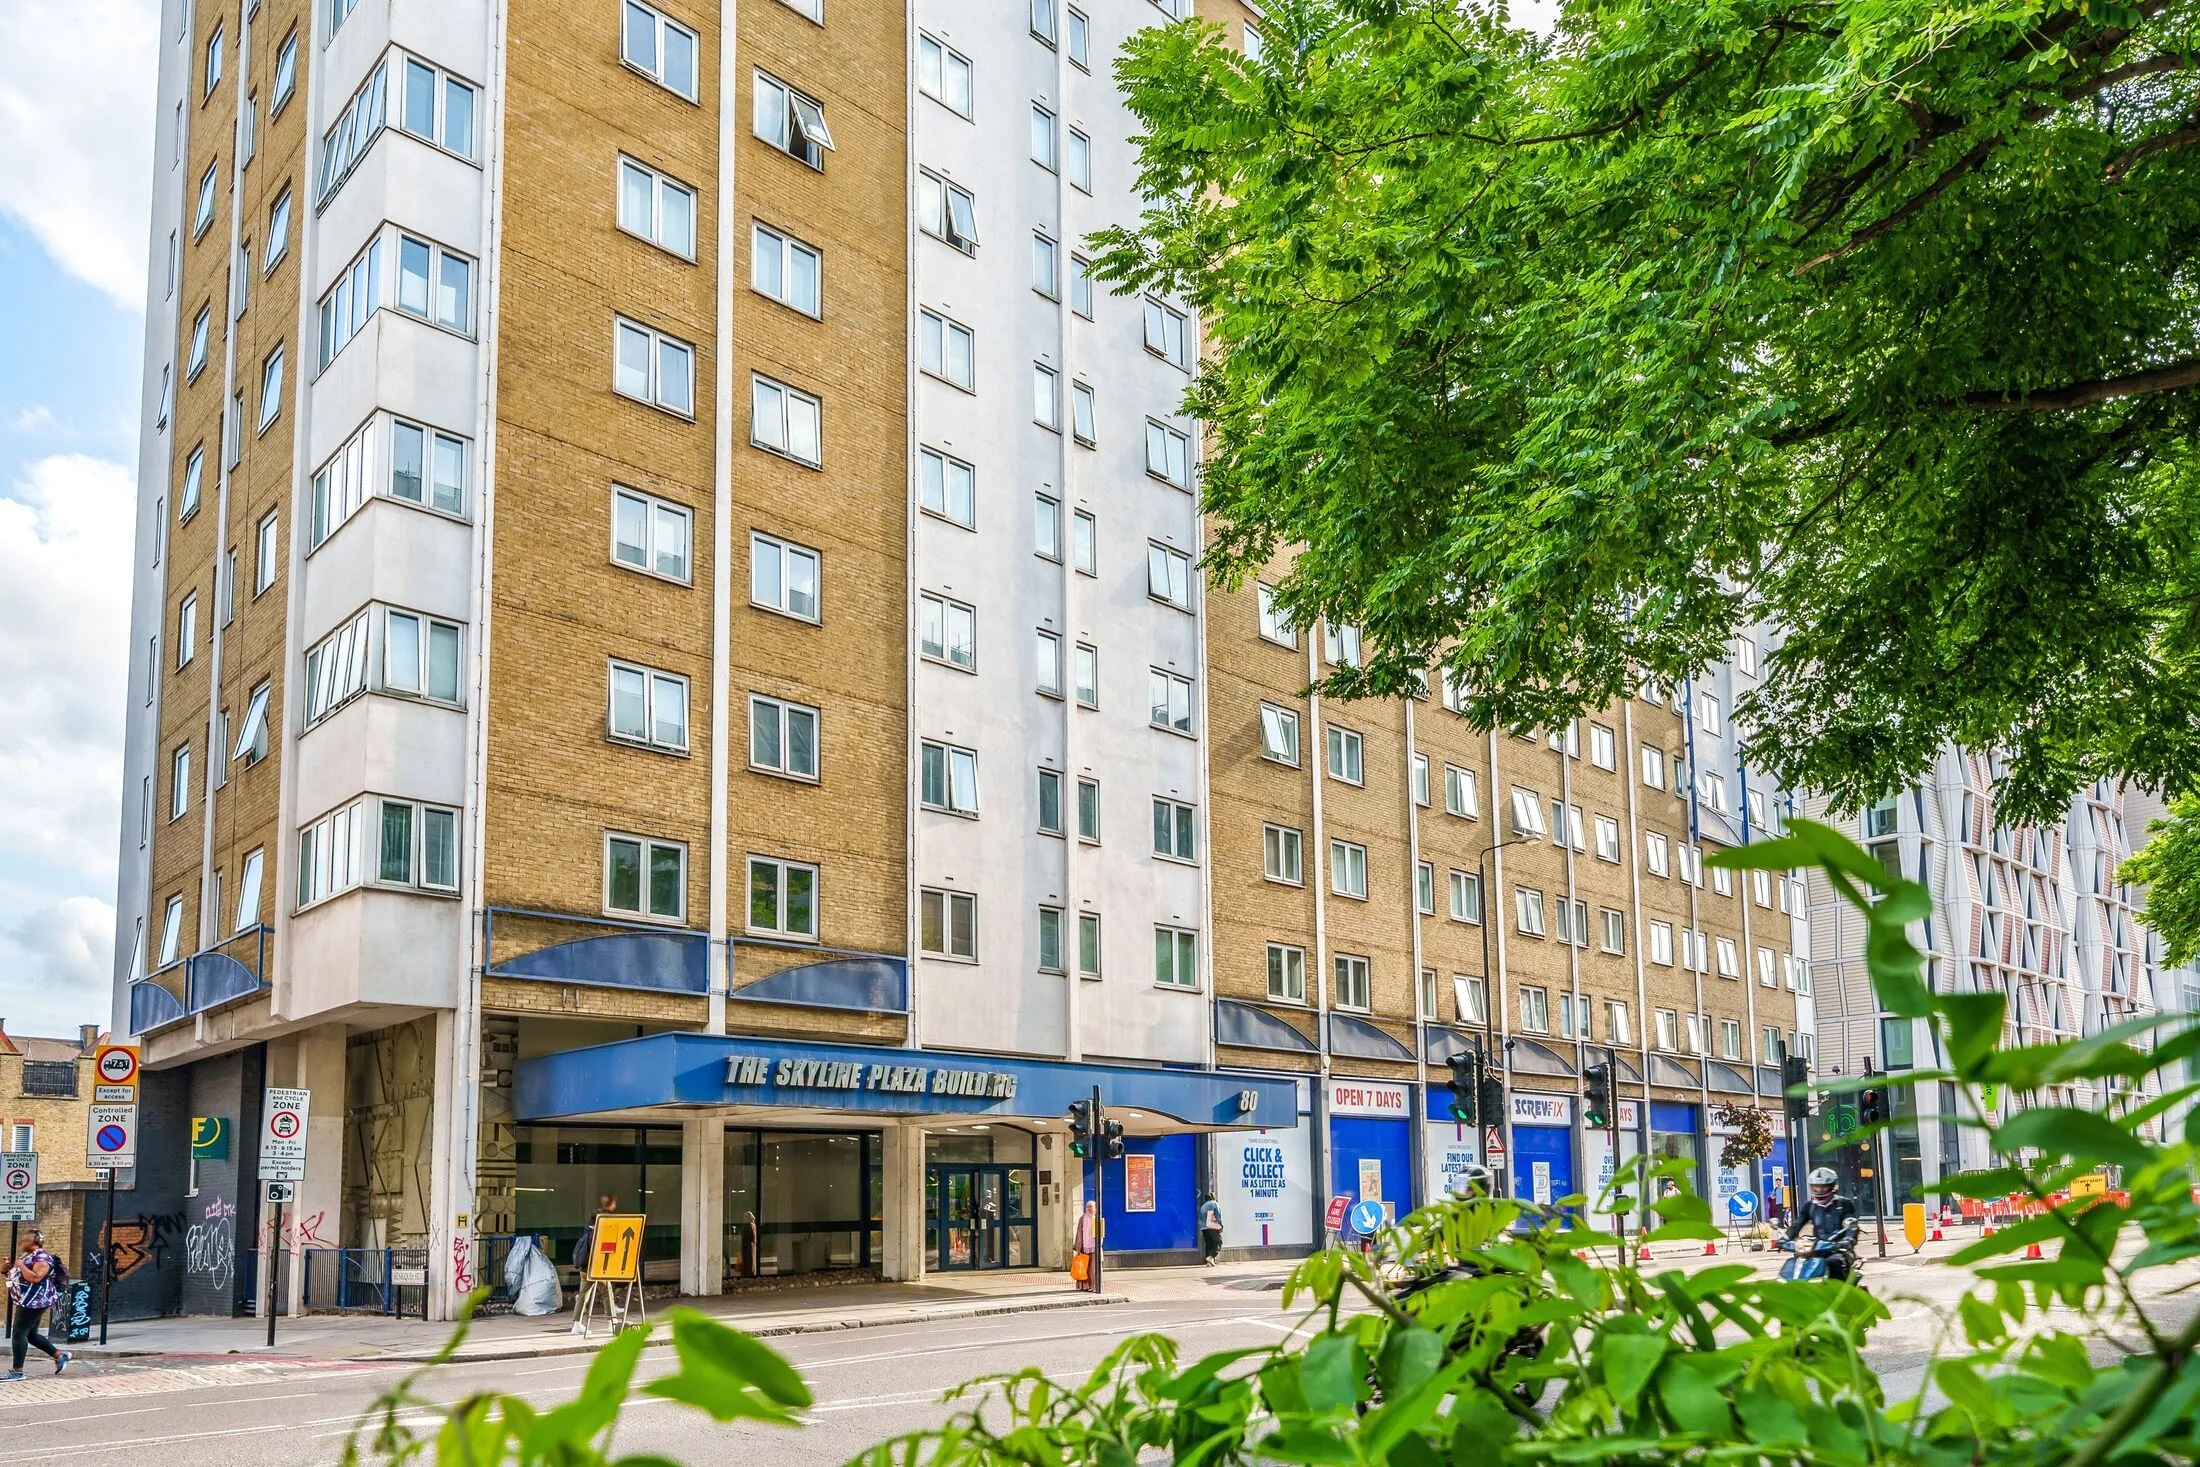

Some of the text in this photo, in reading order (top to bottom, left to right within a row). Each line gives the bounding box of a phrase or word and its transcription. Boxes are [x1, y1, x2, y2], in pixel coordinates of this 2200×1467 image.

[727, 1056, 770, 1084] THE
[776, 1058, 863, 1089] SKYLINE
[866, 1064, 927, 1092] PLAZA
[98, 1087, 121, 1095] Except
[1240, 1090, 1258, 1111] 80
[1336, 1087, 1402, 1109] OPEN 7 DAYS
[273, 1101, 300, 1109] ZONE
[1619, 1107, 1632, 1118] AYS
[98, 1115, 127, 1123] ZONE
[1244, 1147, 1282, 1162] CLICK &
[1446, 1153, 1473, 1162] FIND OUR
[1603, 1155, 1613, 1164] OVE
[1242, 1163, 1284, 1179] COLLECT
[1441, 1163, 1461, 1173] LATEST
[1447, 1174, 1453, 1183] &
[1724, 1177, 1738, 1185] MINUTE
[1242, 1179, 1286, 1188] IN AS LITTLE AS
[1250, 1189, 1278, 1198] 1 MINUTE
[1720, 1185, 1737, 1193] DELIVERY
[1331, 1208, 1341, 1216] LANE
[458, 1215, 467, 1226] H
[1327, 1215, 1340, 1225] CLOSED
